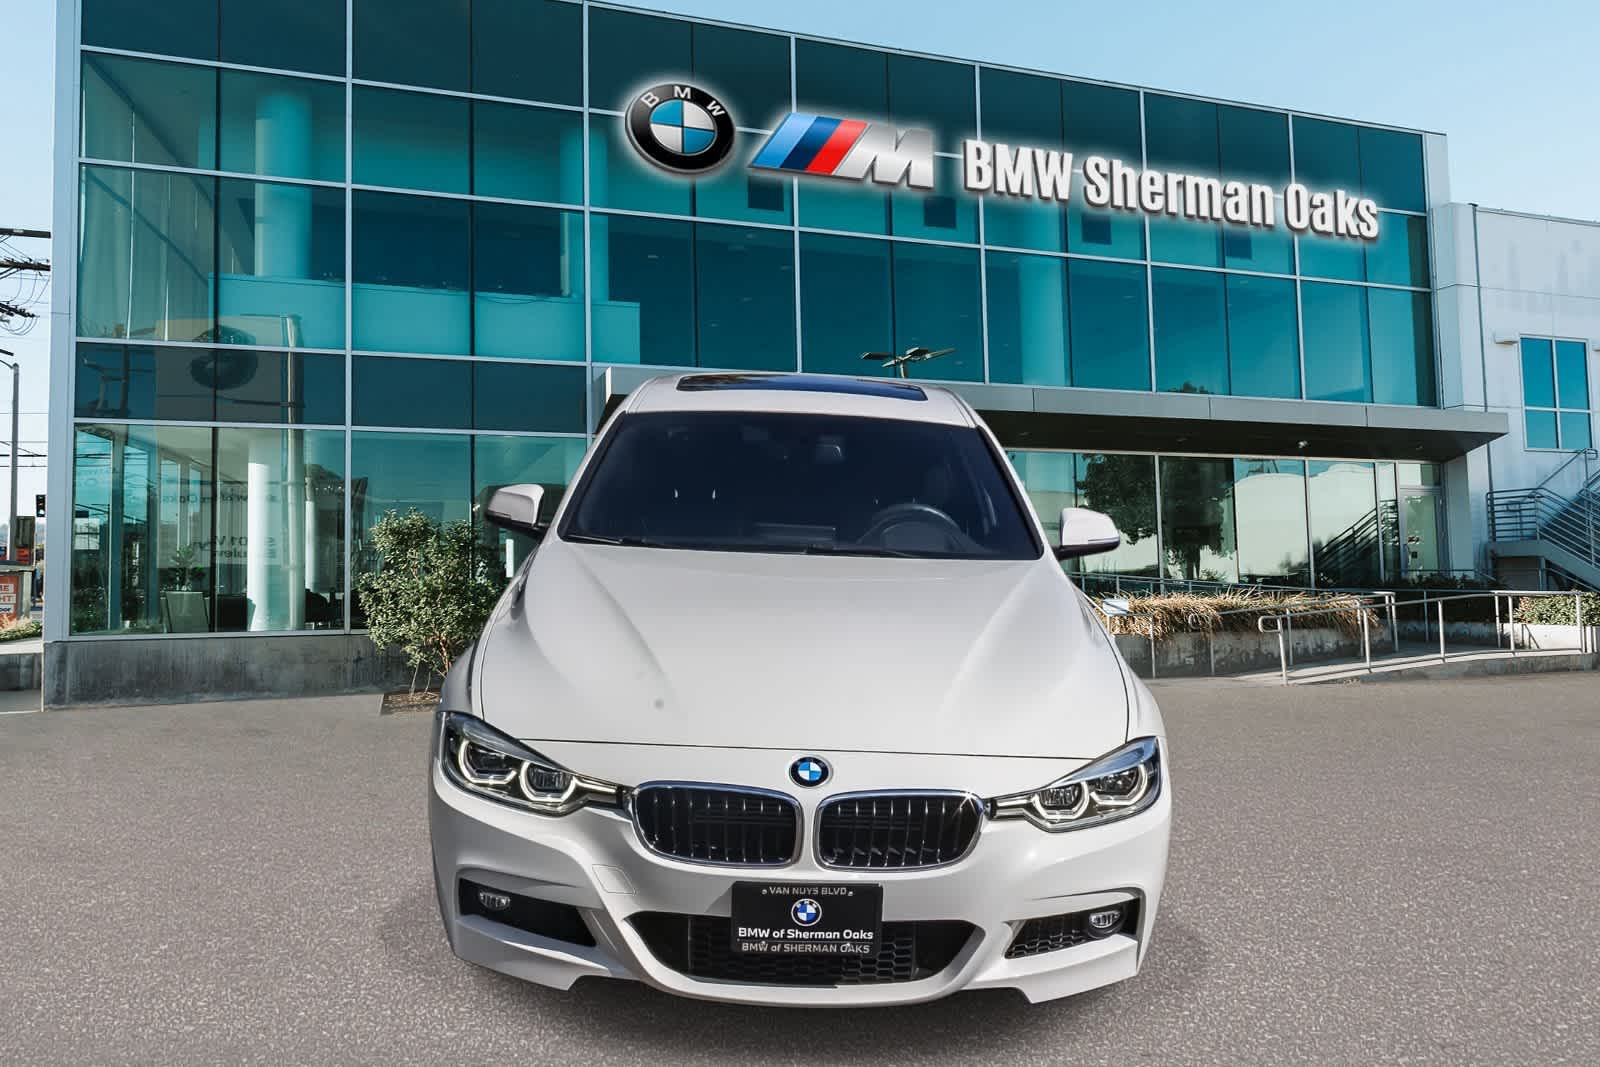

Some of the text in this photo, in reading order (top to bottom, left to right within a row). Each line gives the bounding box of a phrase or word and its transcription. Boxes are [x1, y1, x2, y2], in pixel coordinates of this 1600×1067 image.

[640, 85, 725, 117] BMW
[963, 139, 1379, 241] BMW Sherman Oaks
[769, 886, 847, 896] VAN NUYS BLVD
[738, 927, 874, 940] BMW of Sherman Oaks
[741, 942, 870, 954] BMW of SHERMAN OAKS
